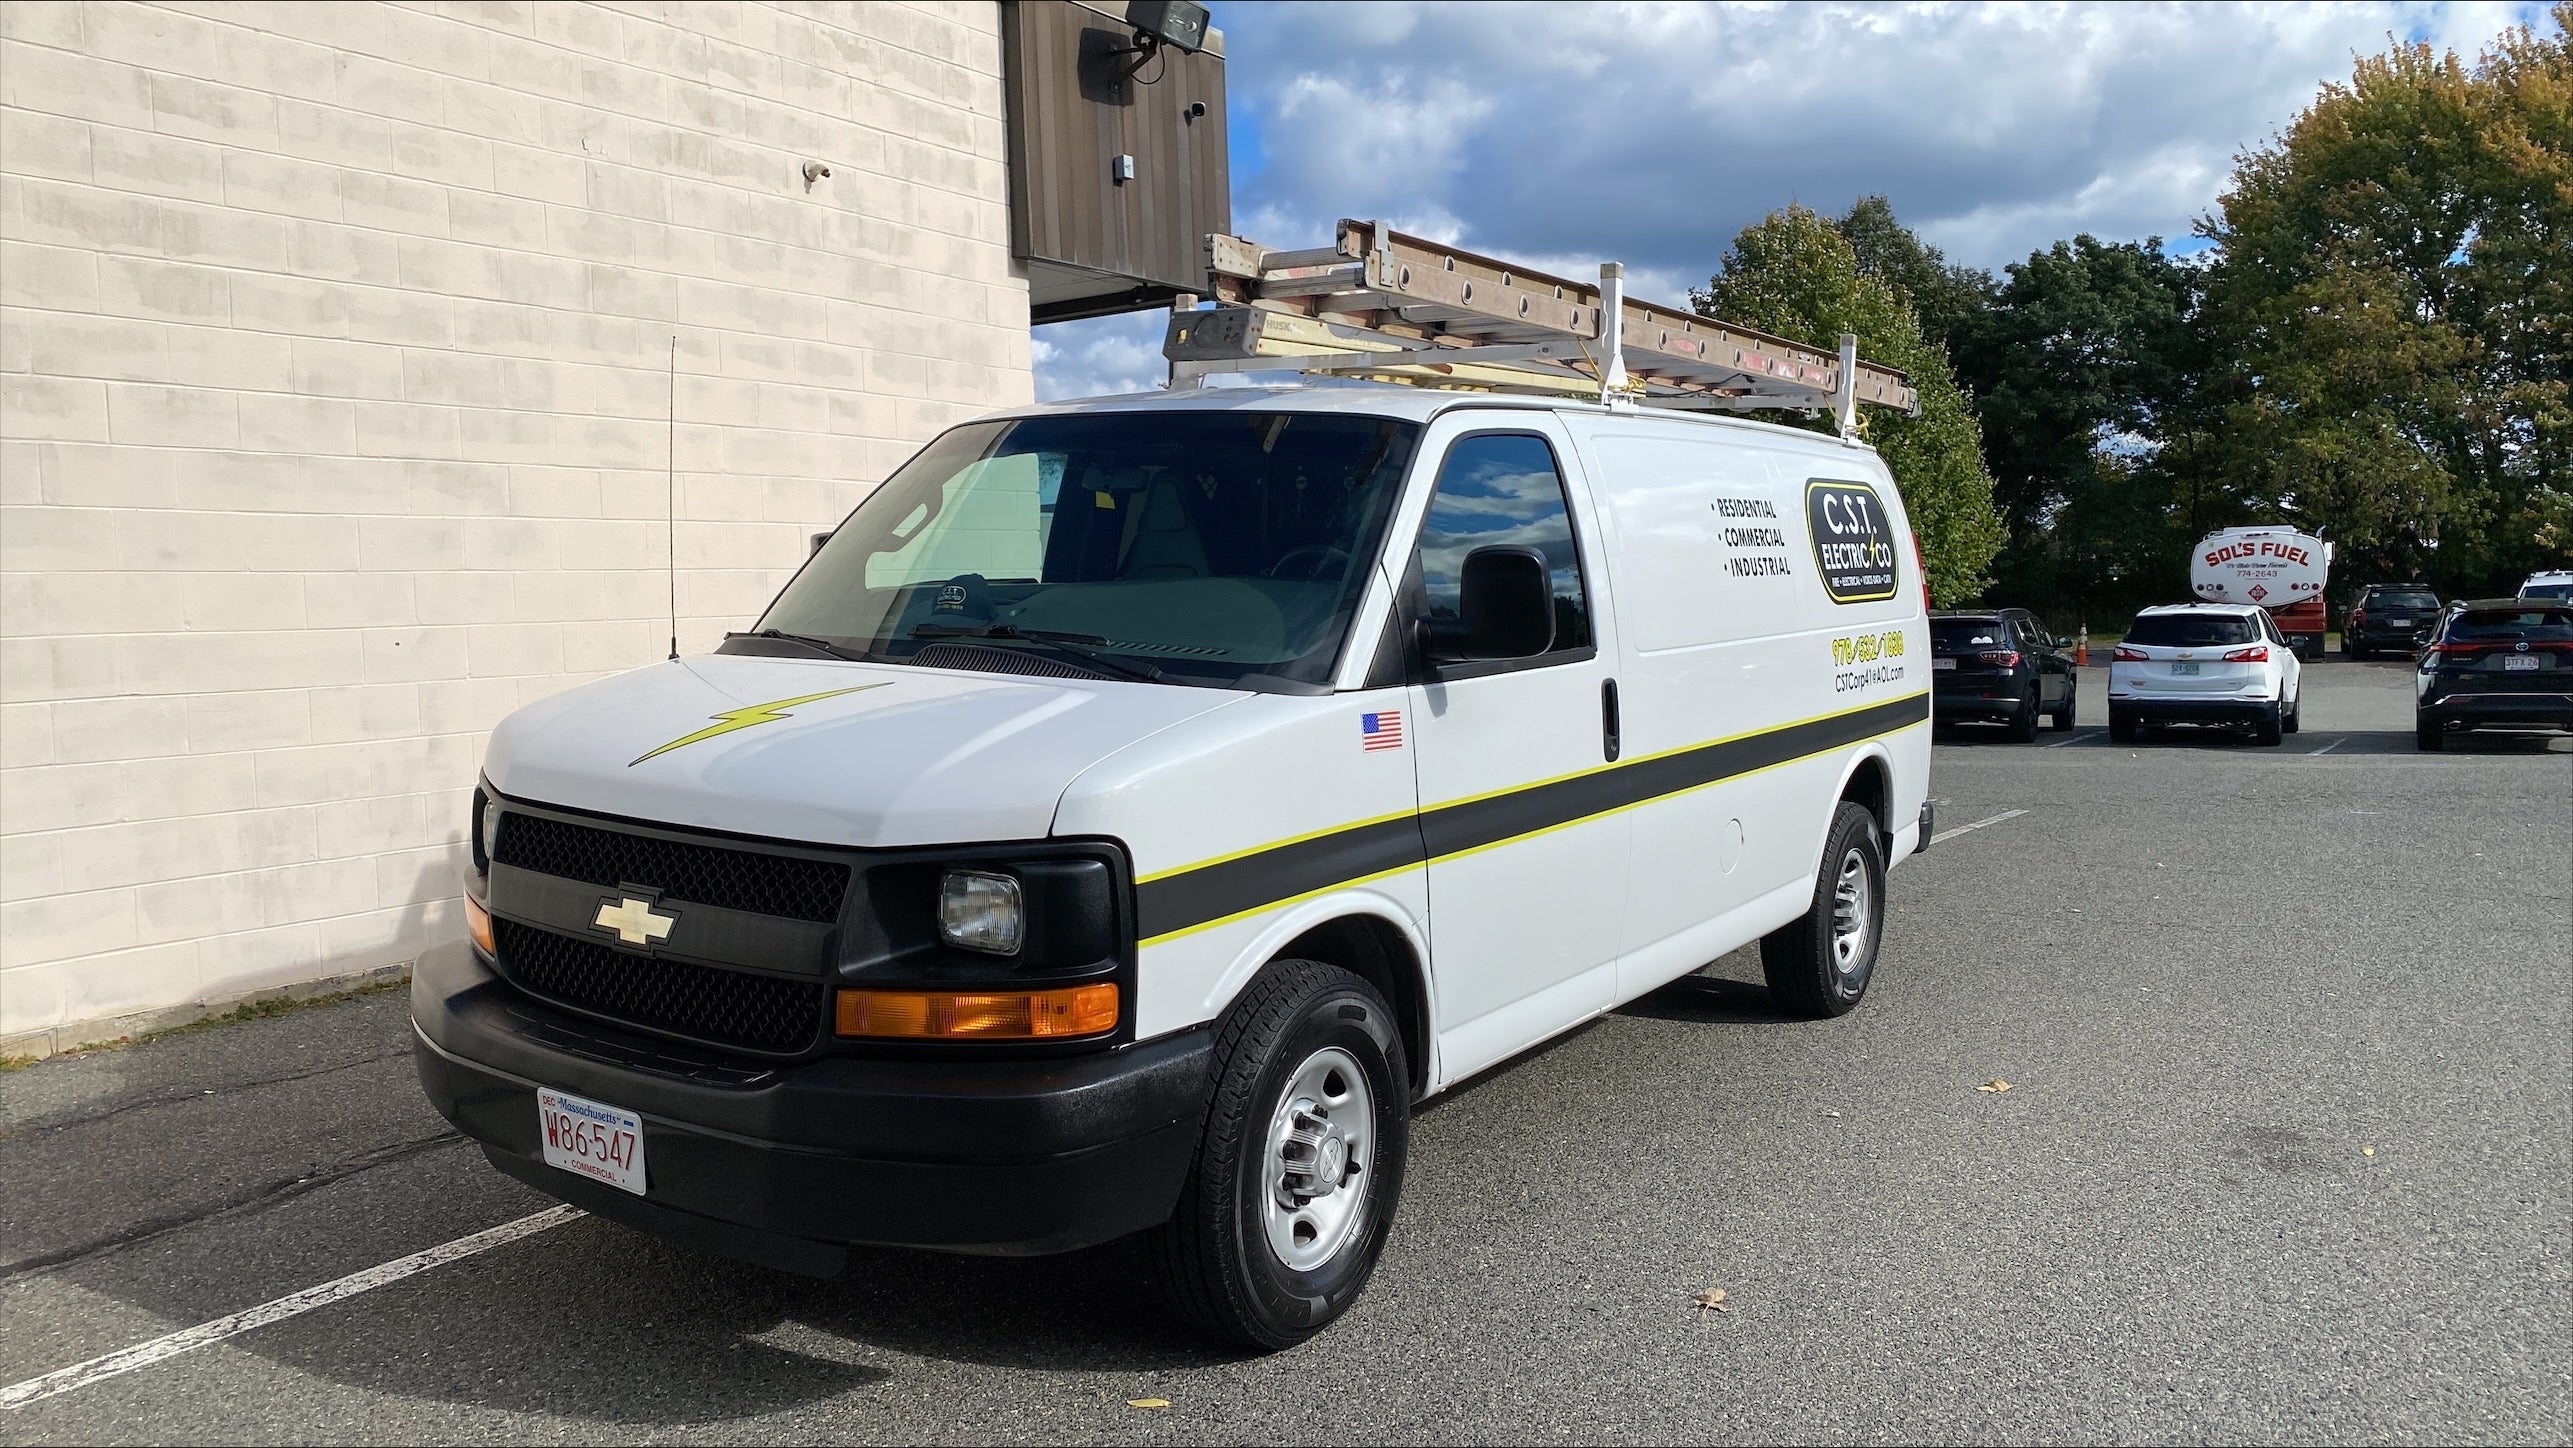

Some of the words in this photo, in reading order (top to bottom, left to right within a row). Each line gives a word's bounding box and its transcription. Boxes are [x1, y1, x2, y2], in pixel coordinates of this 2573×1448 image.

[1716, 498, 1777, 518] RESIDENTIAL
[1823, 493, 1878, 535] C.S.T.
[1724, 528, 1785, 547] COMMERCIAL
[1821, 542, 1870, 570] ELECTRIC
[2204, 542, 2255, 567] SOL'S
[2261, 542, 2310, 567] FUEL
[1730, 557, 1791, 578] INDUSTRIAL
[2236, 570, 2278, 578] 774-2643
[1835, 665, 1905, 692] CSTCorp41@AOL.com
[542, 1095, 556, 1107] DEC
[559, 1097, 617, 1125] Massachusetts
[571, 1159, 617, 1182] COMMERCIAL
